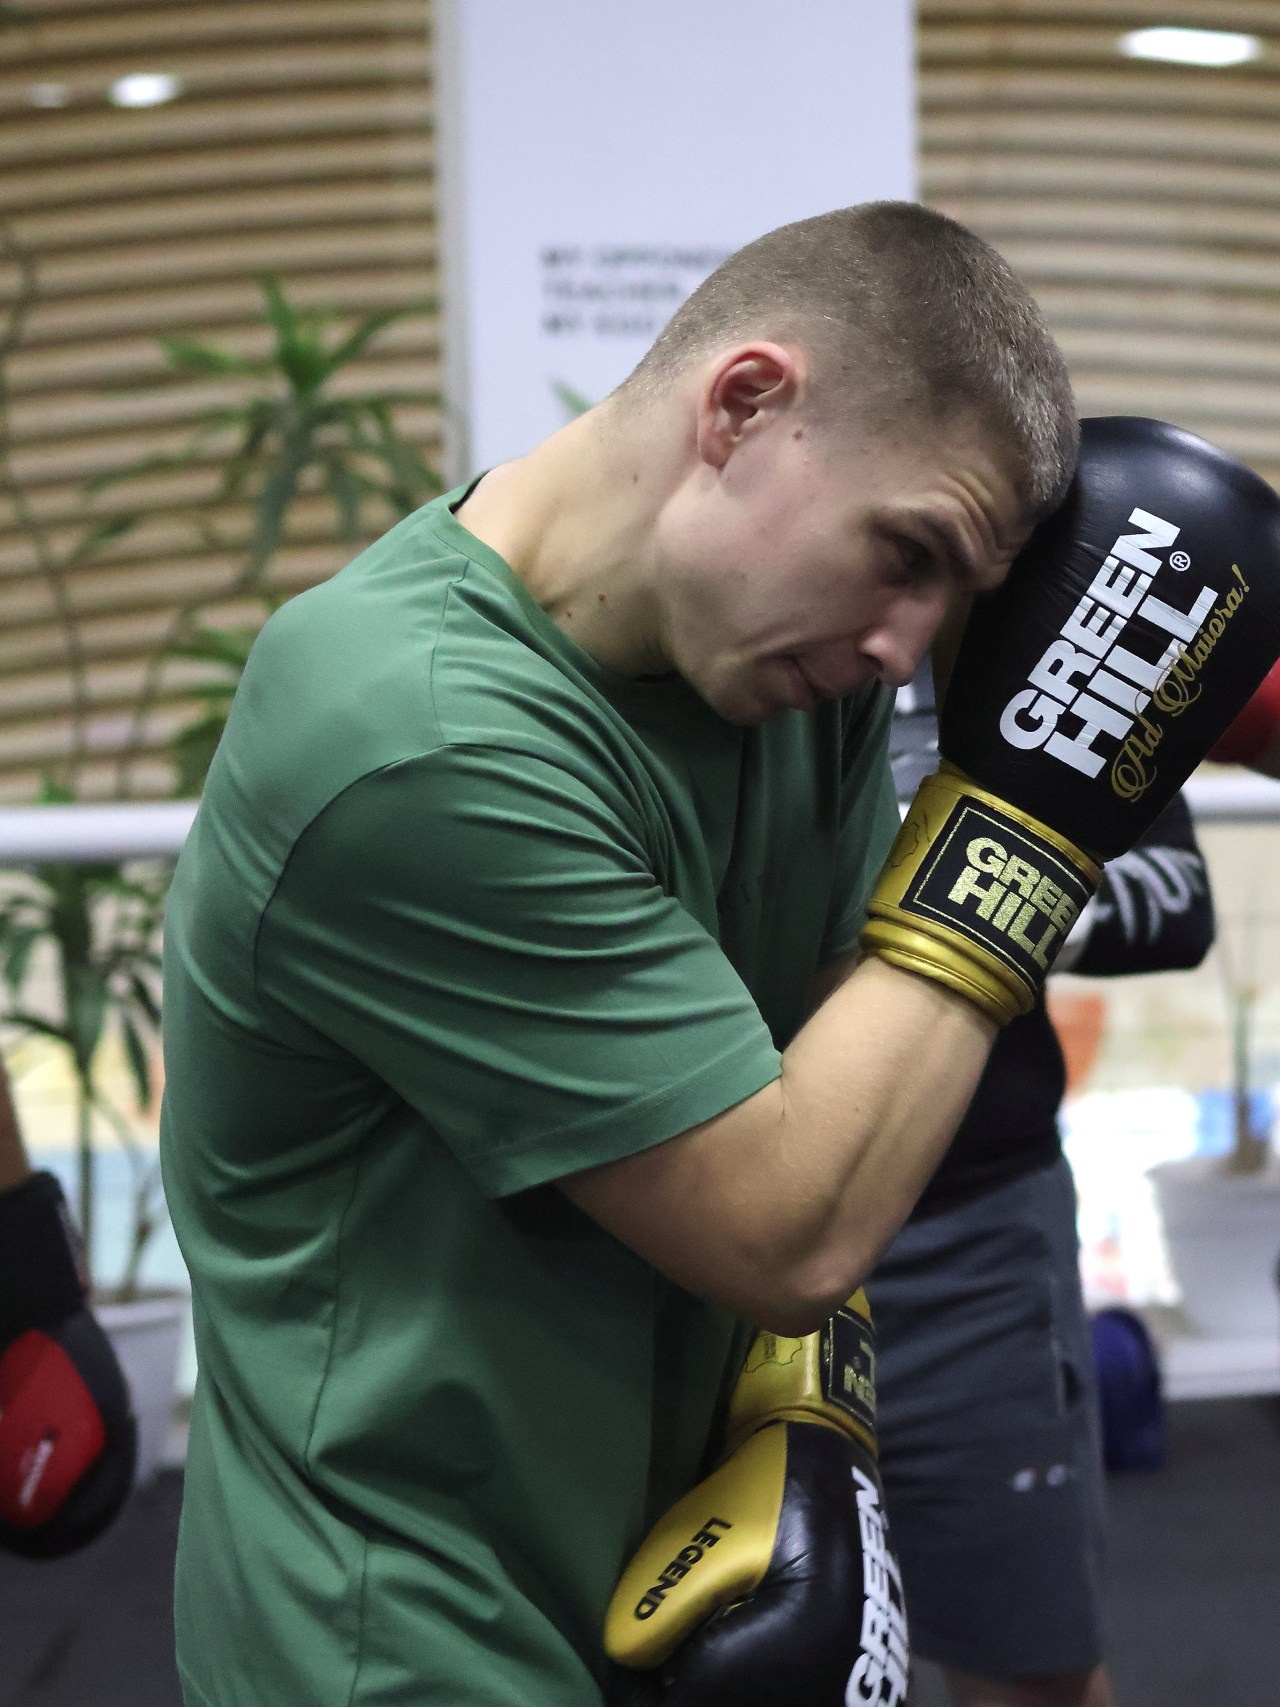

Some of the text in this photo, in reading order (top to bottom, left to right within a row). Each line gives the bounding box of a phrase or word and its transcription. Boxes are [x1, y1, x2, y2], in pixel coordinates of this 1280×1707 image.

[1000, 507, 1181, 750] GREEN
[1043, 585, 1219, 780] HILL
[1111, 687, 1163, 803] Ad
[947, 865, 1058, 971] HILL
[965, 836, 1080, 937] GREE
[634, 1516, 732, 1621] LEGEND
